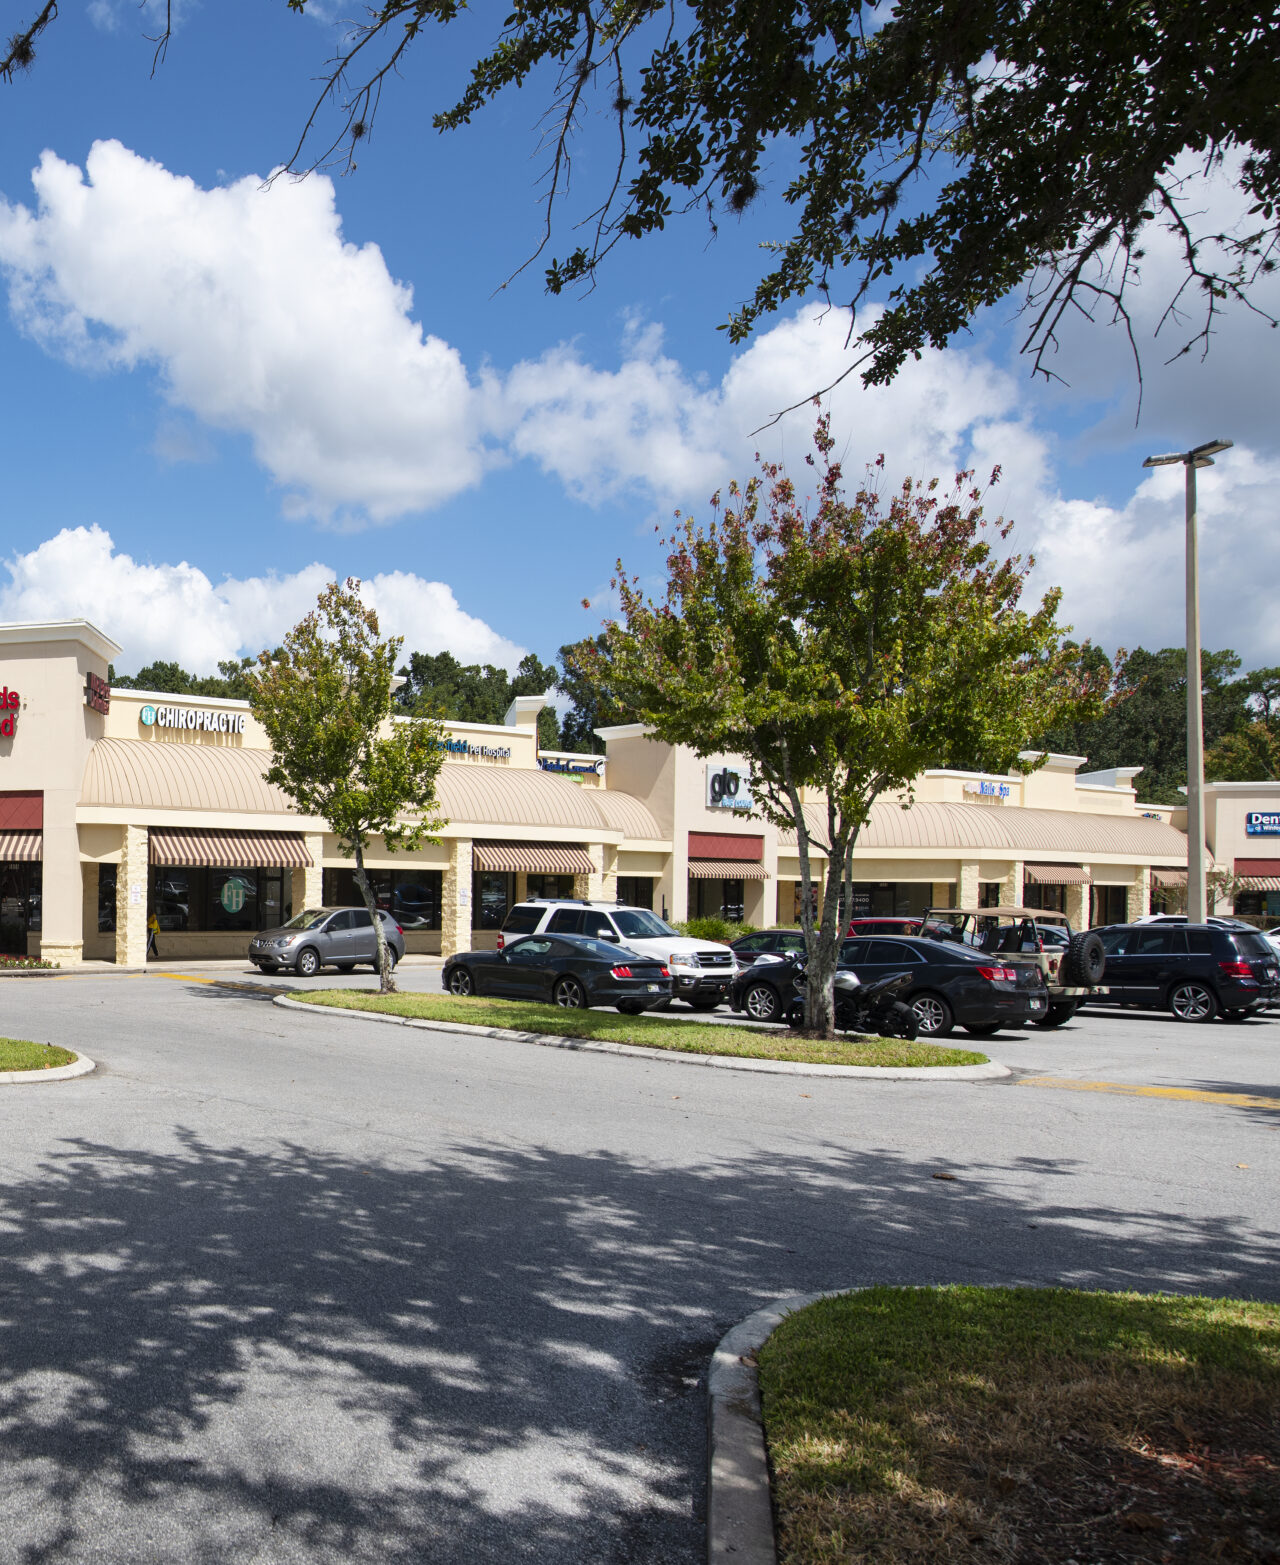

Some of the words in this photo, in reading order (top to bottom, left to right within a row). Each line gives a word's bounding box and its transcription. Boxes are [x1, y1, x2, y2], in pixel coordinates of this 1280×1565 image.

[157, 706, 246, 734] CHIROPRACTIC
[470, 744, 482, 755] Pet
[483, 746, 511, 758] Hospital
[1251, 813, 1280, 824] Den
[223, 883, 243, 910] FH
